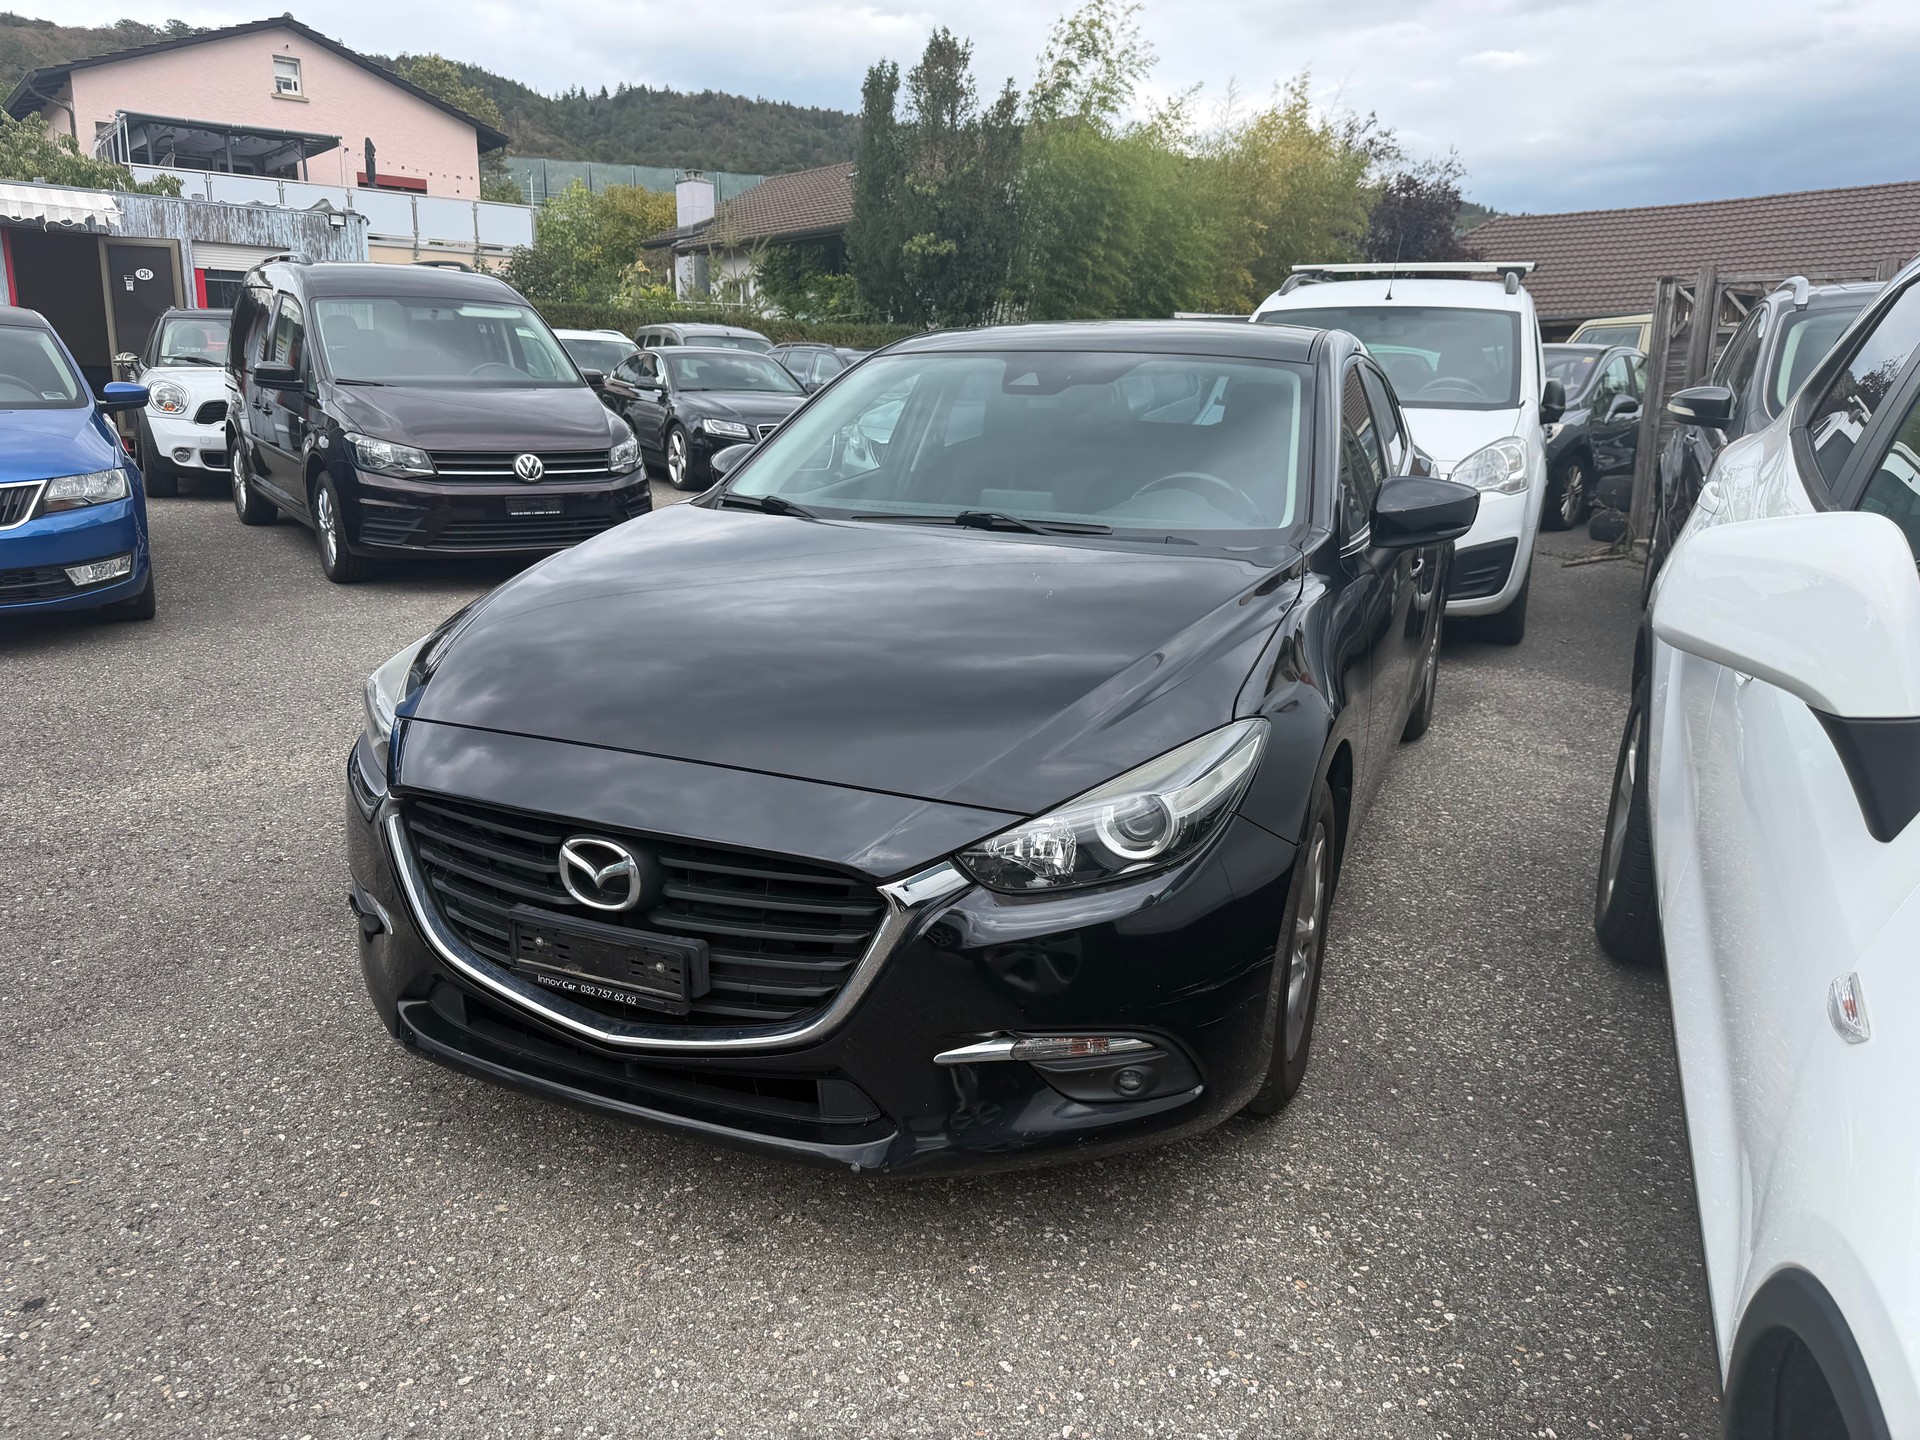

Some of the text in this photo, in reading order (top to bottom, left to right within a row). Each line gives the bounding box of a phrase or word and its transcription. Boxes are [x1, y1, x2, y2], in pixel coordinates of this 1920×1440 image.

[139, 269, 150, 279] CH
[516, 453, 543, 481] VW
[537, 974, 637, 1005] Innov'Car 032 757 62 62
